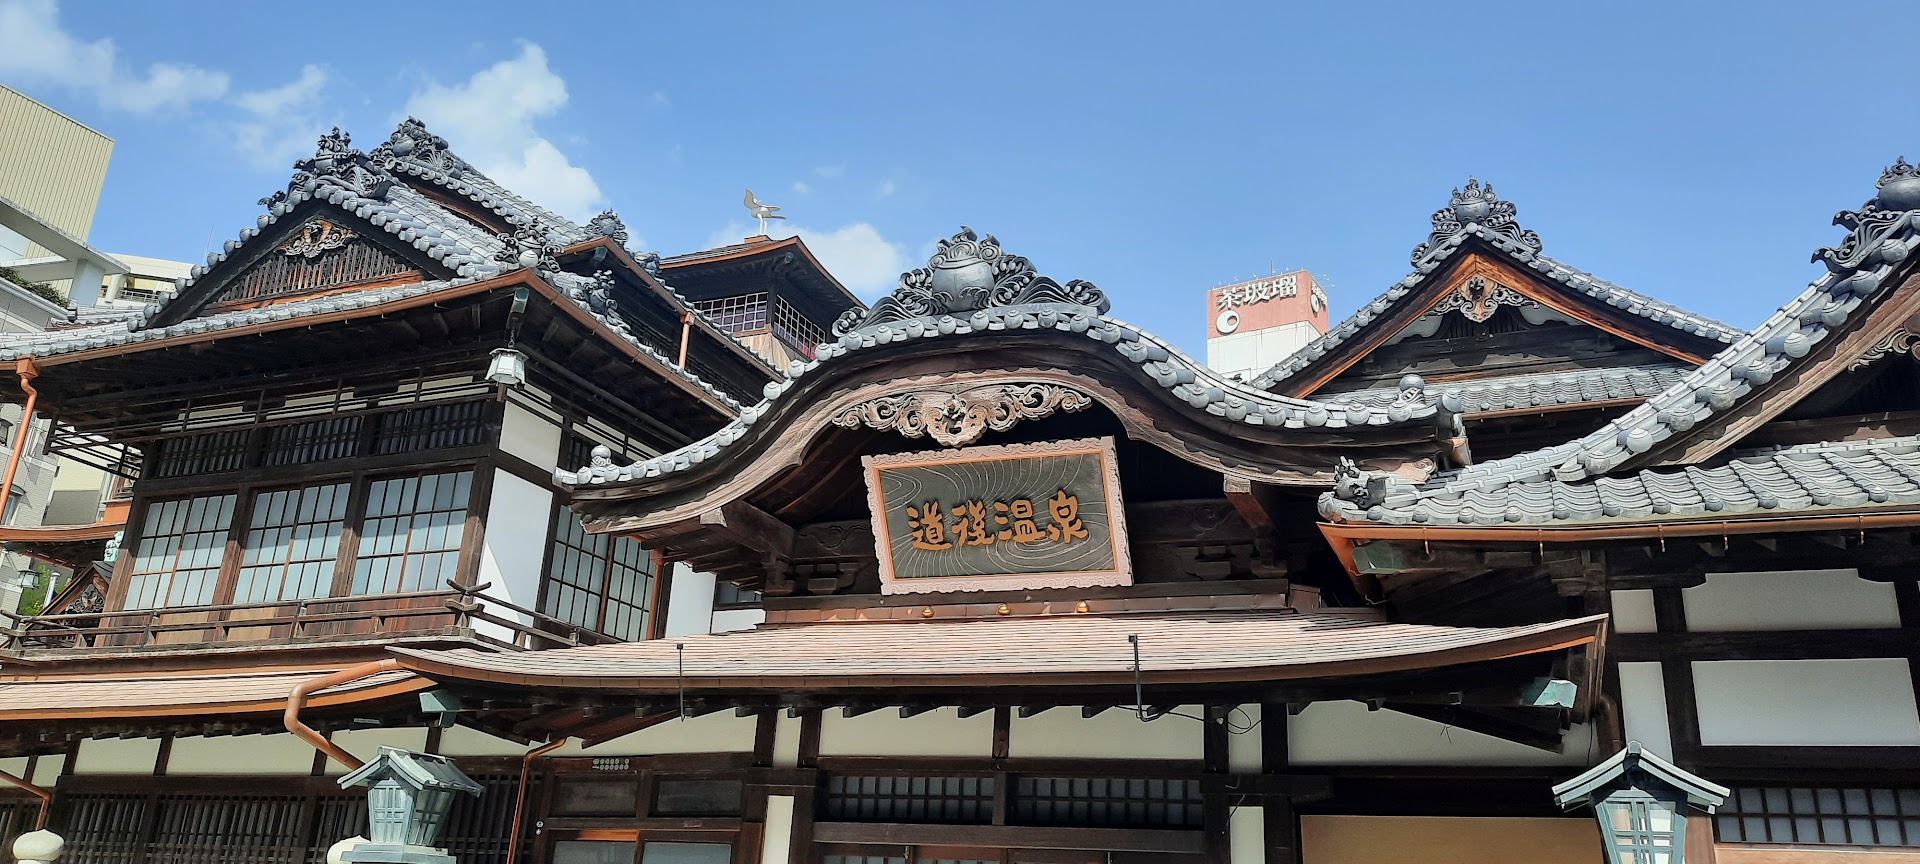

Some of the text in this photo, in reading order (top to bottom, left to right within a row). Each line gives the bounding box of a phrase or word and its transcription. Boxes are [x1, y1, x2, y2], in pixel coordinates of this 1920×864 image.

[1217, 275, 1297, 309] 茶玻瑠
[906, 489, 1089, 550] 道後温泉
